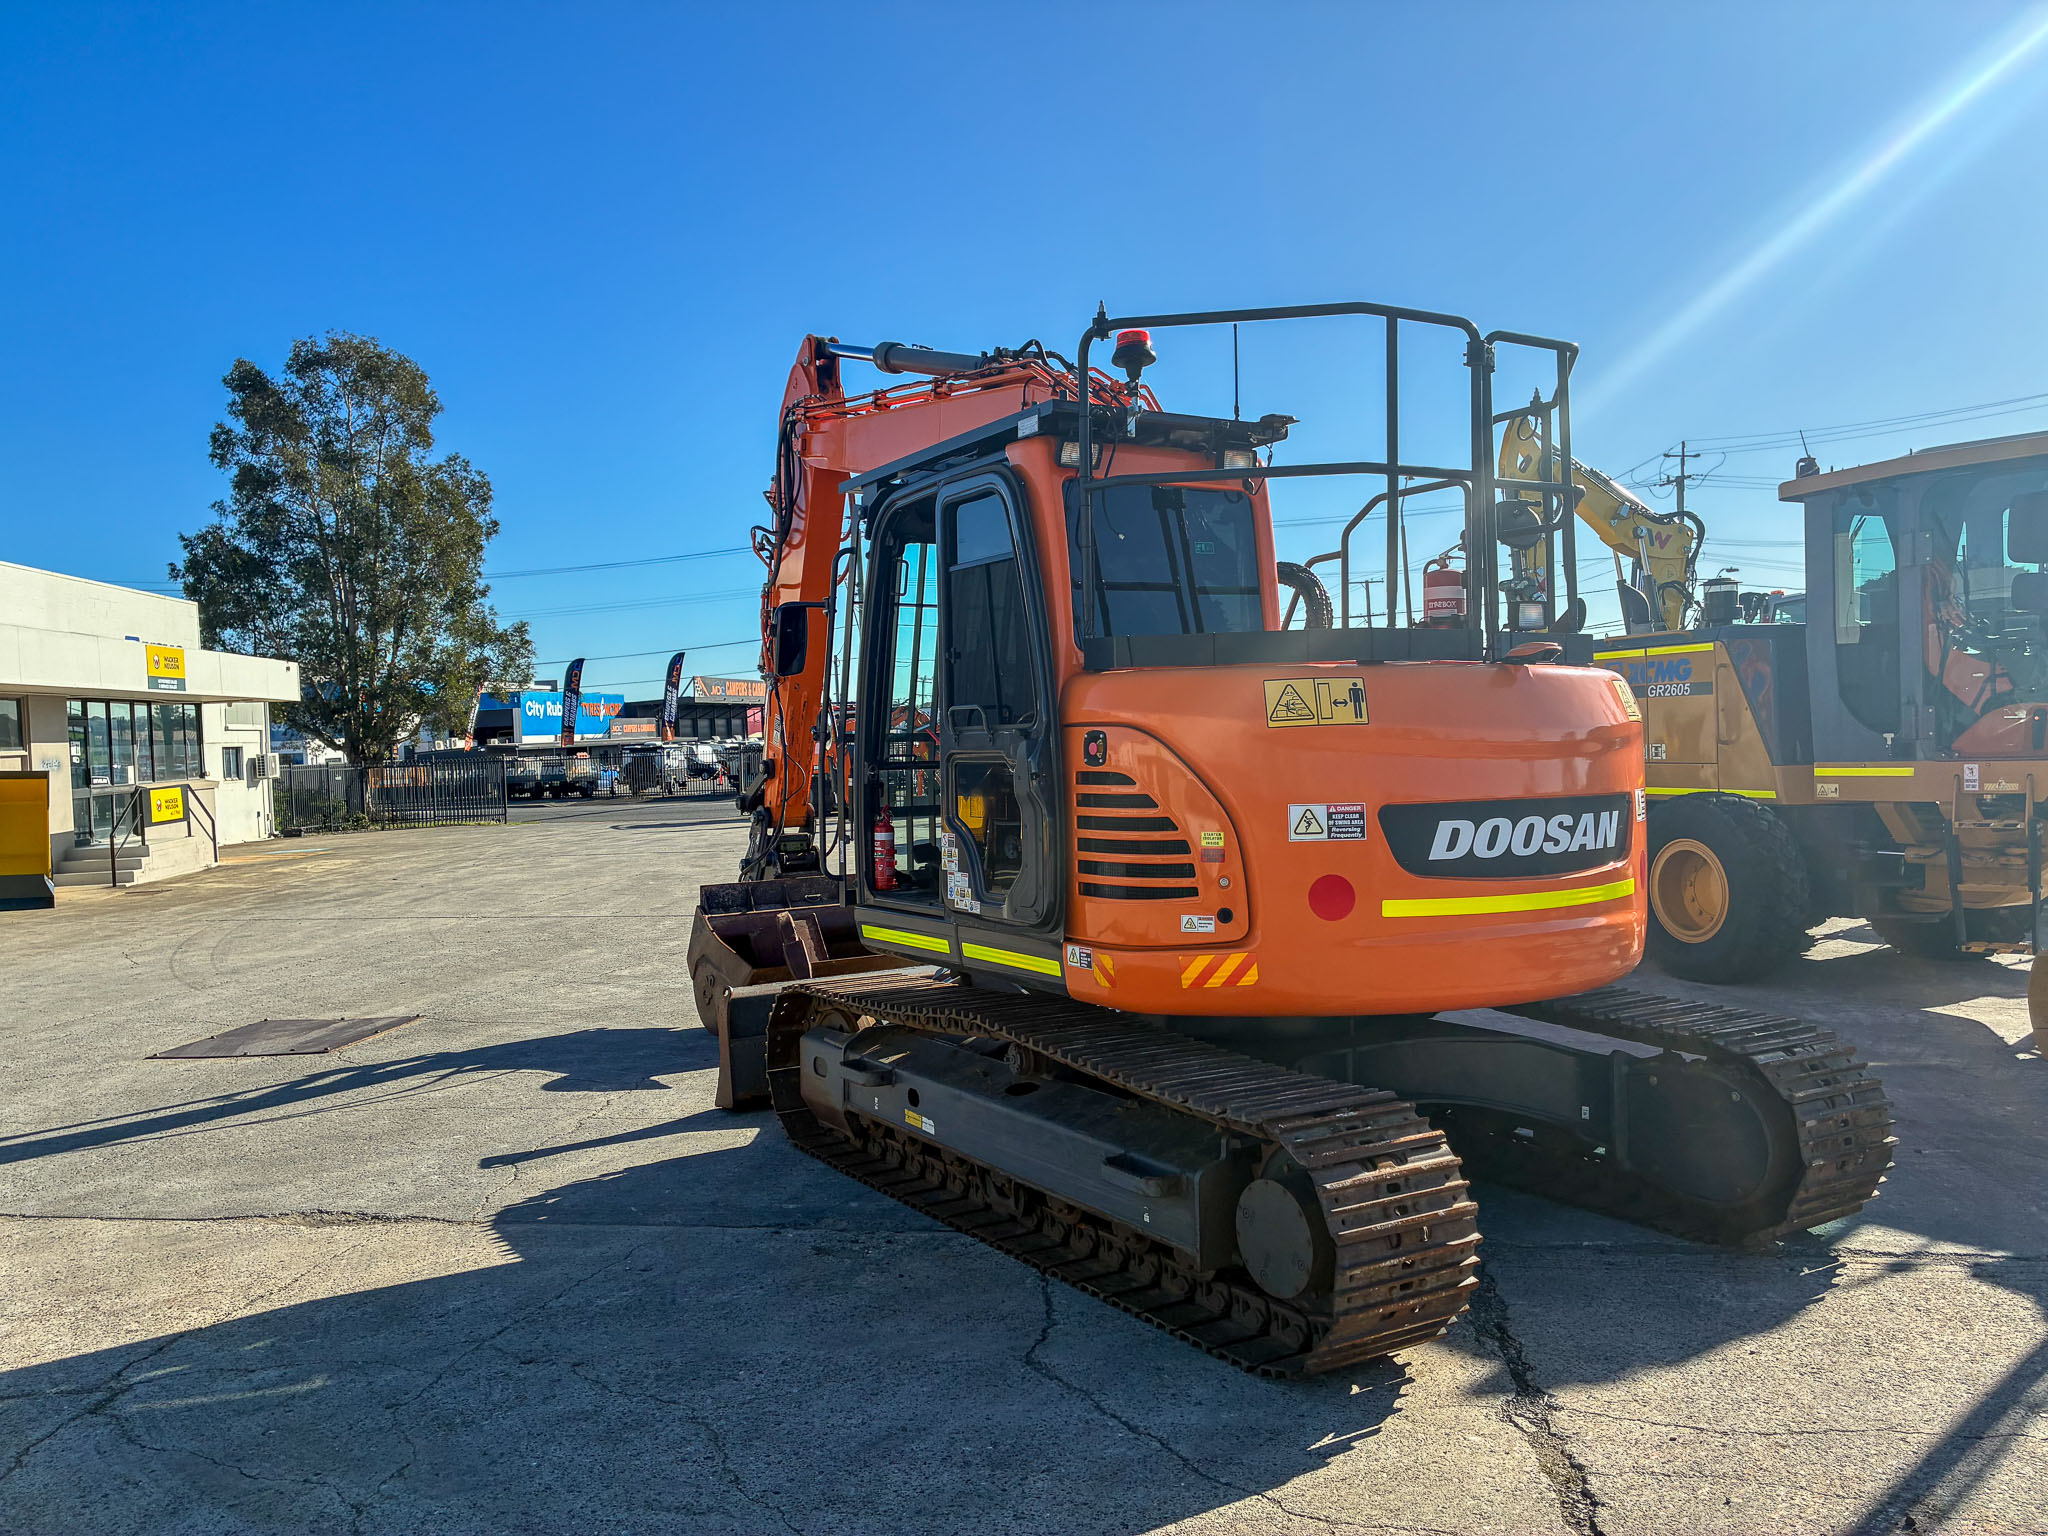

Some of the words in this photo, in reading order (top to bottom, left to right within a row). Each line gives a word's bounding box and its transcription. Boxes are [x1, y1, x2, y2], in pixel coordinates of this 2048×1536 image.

[1626, 658, 1693, 684] XCMG
[726, 680, 747, 697] CAMPERS
[1647, 683, 1691, 697] GR2605
[526, 700, 544, 719] City
[569, 693, 577, 727] CARAVANS
[580, 702, 600, 717] TYRES
[1428, 810, 1619, 861] DOOSAN
